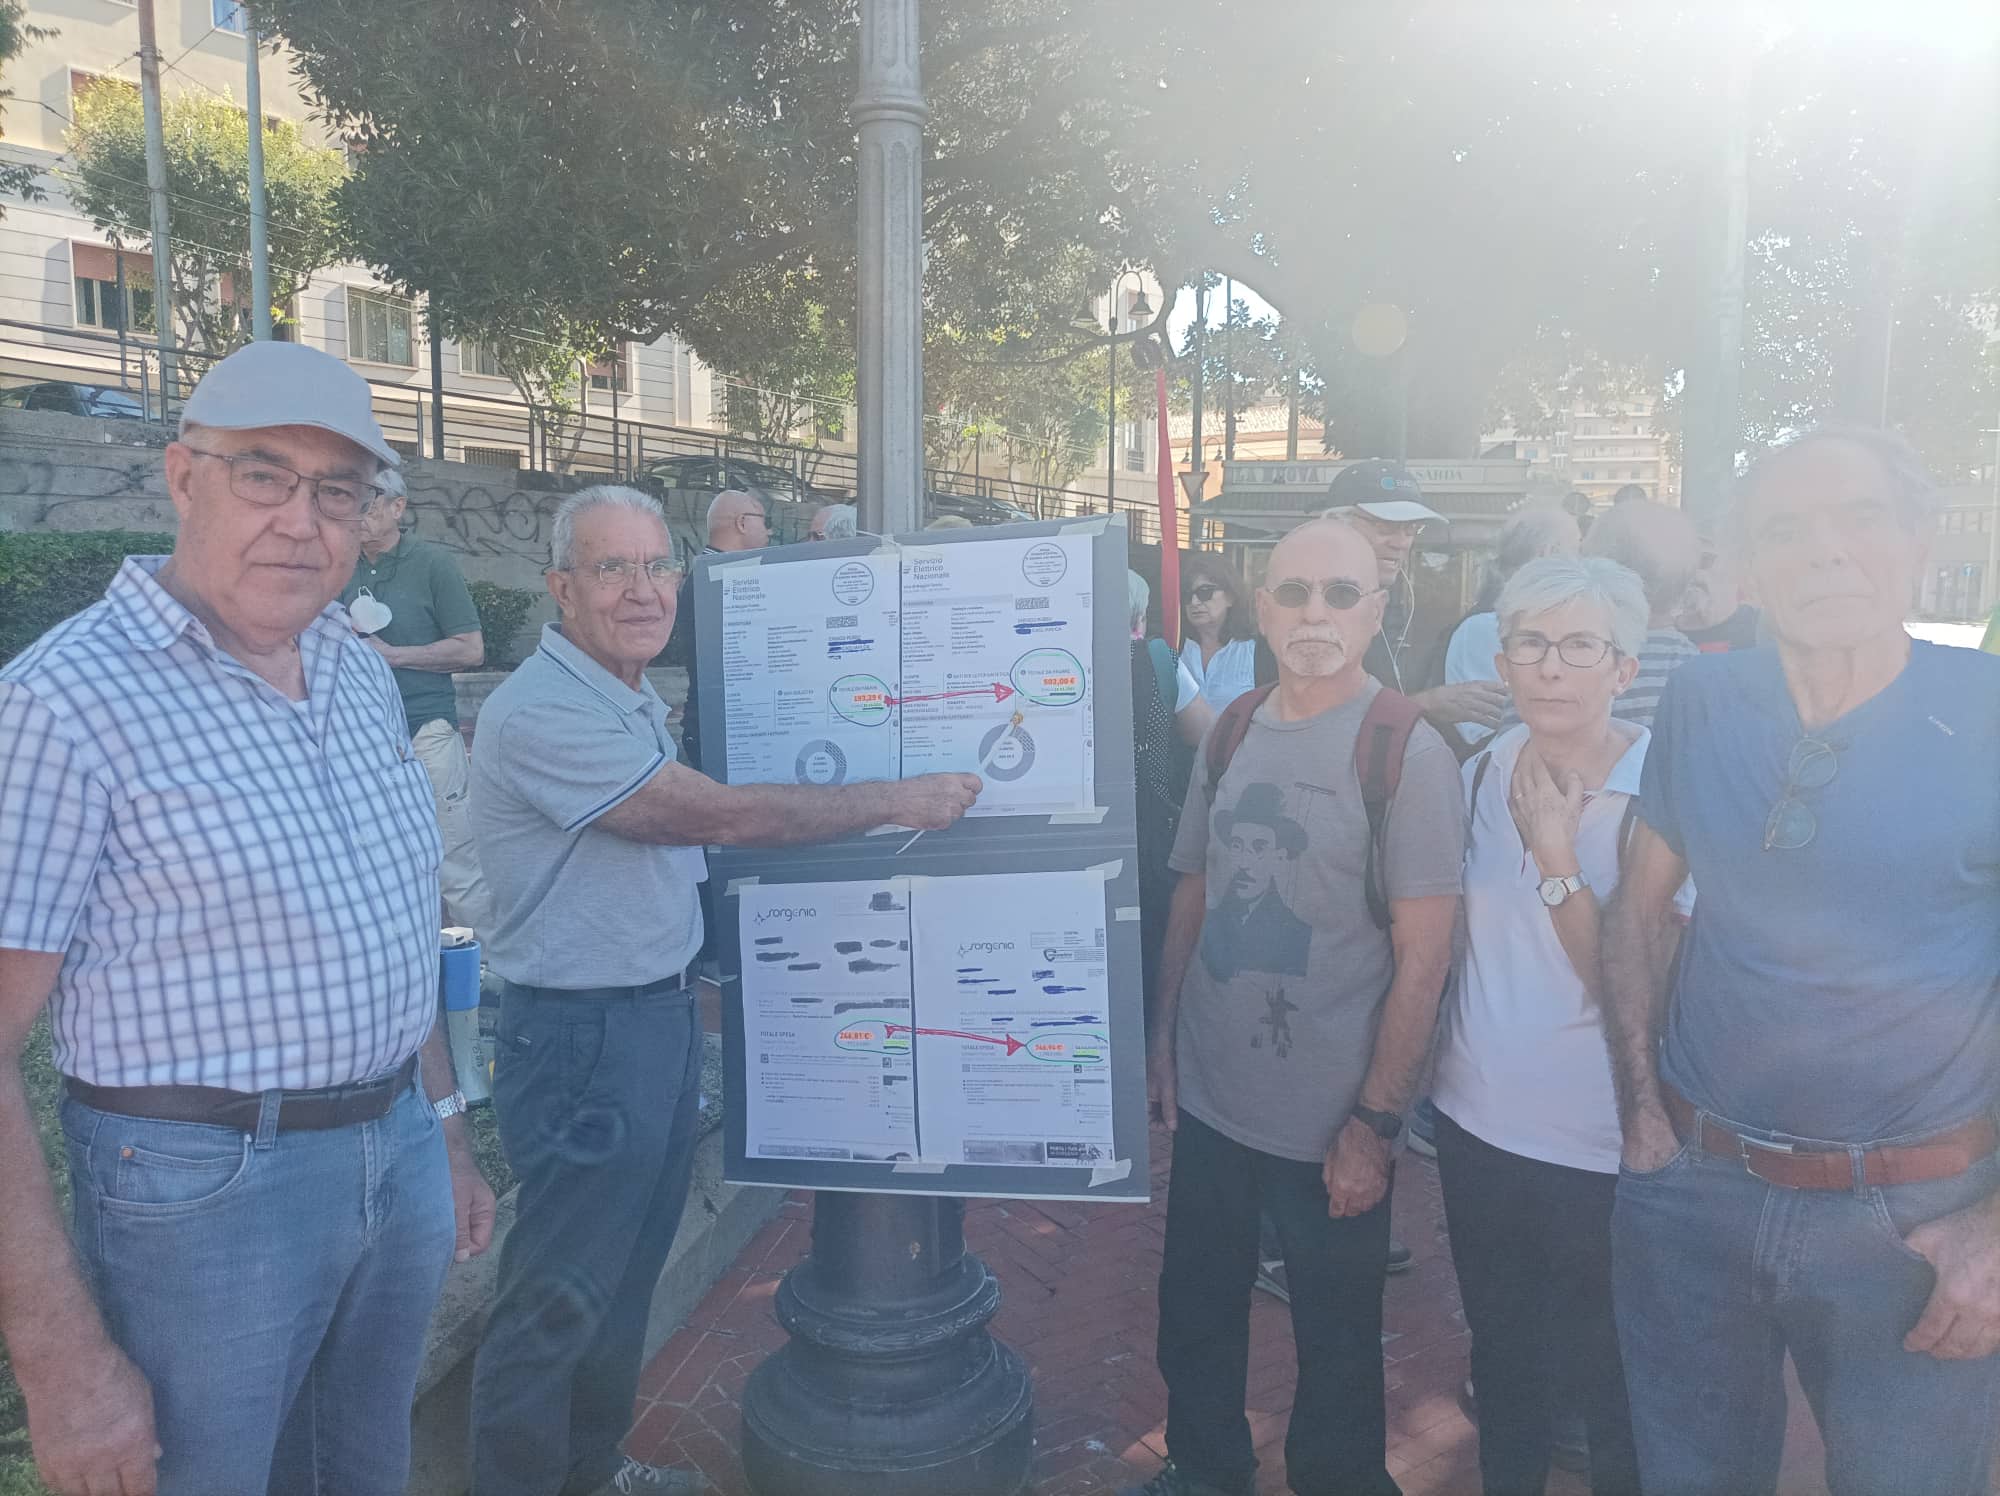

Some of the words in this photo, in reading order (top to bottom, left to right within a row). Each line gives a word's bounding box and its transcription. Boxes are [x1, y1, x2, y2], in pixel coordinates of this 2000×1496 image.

[913, 558, 943, 566] Servizio
[913, 564, 944, 573] Elettrico
[913, 571, 950, 581] Nazionale
[732, 578, 760, 586] Servizio
[732, 586, 761, 594] Elettrico
[732, 592, 767, 601] Nazionale
[767, 907, 817, 922] sorgenia
[968, 941, 1015, 954] sorgenia
